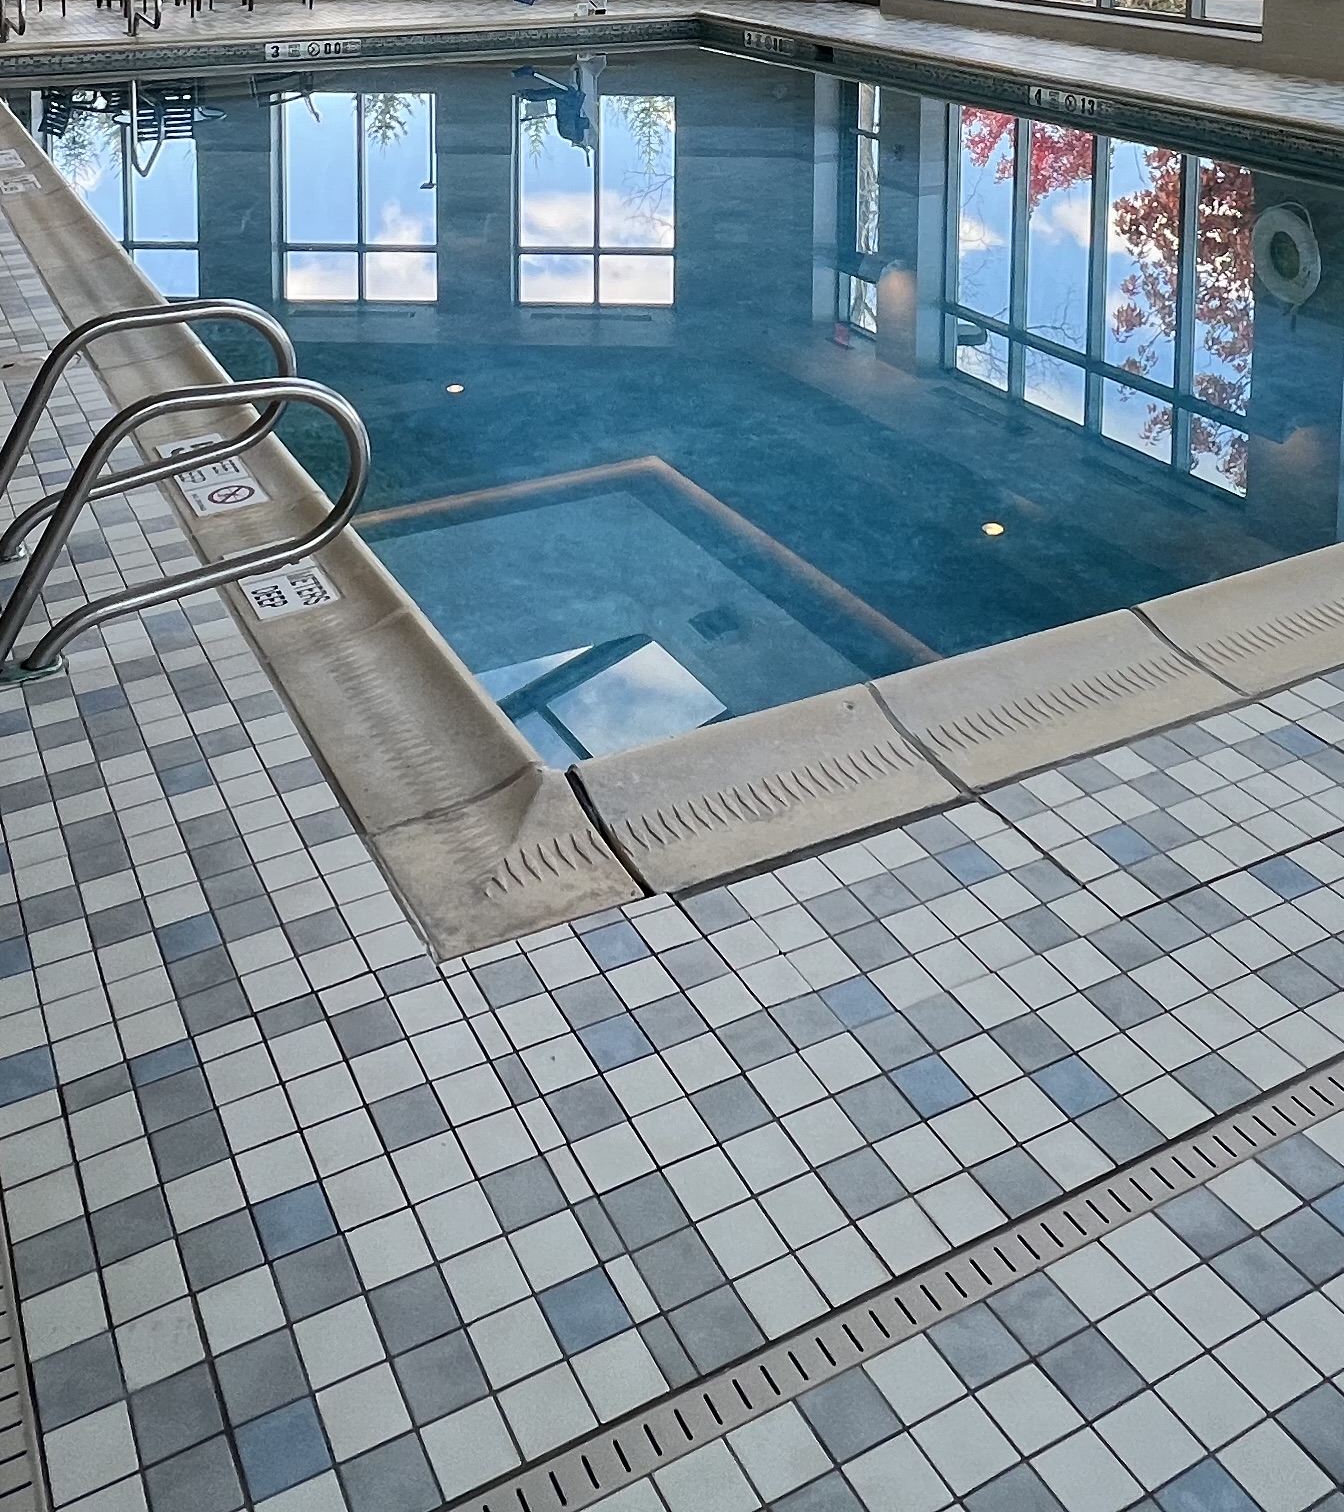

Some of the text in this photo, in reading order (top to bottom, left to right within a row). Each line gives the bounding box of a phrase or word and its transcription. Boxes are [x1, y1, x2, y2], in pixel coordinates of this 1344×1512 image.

[271, 45, 280, 58] 3
[251, 584, 289, 608] DEEP
[286, 569, 331, 606] METERS
